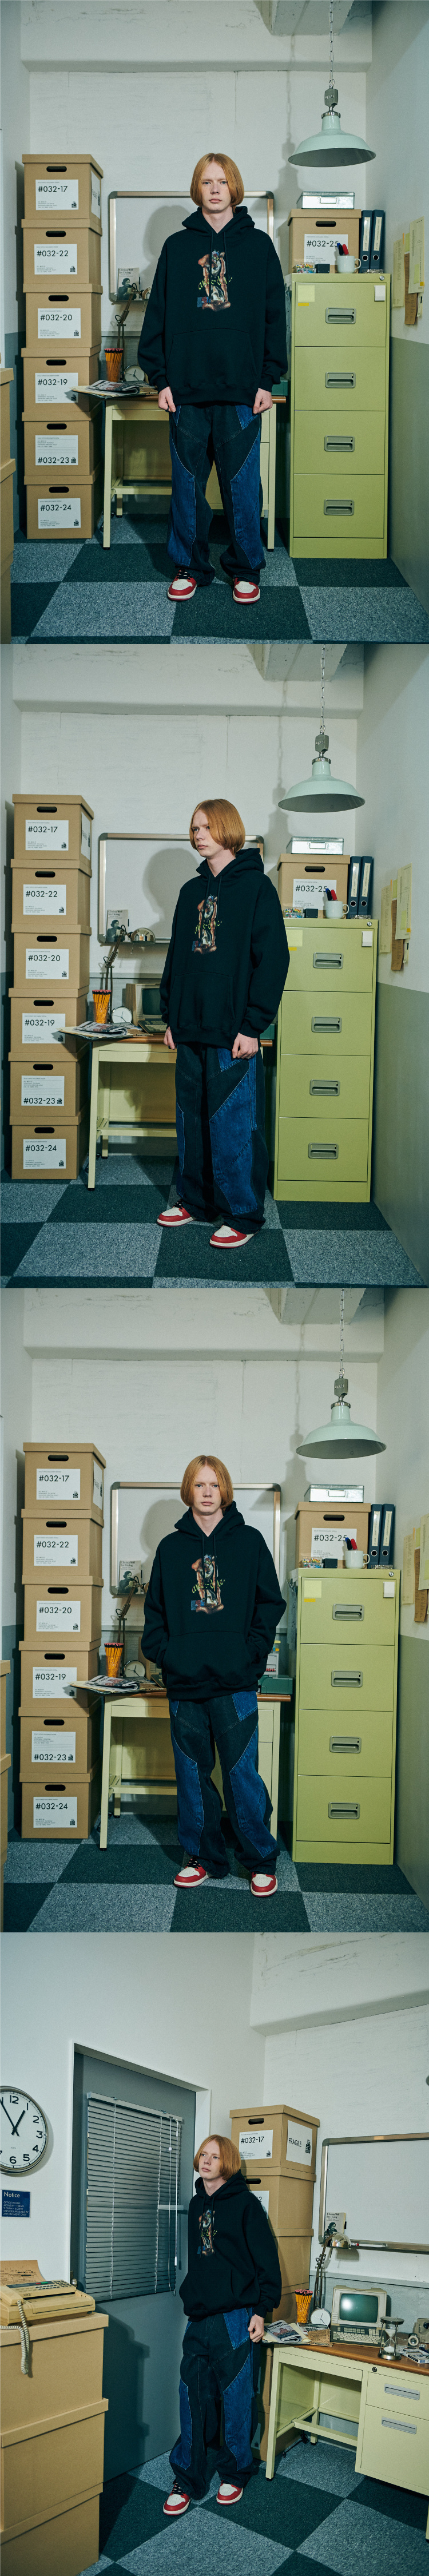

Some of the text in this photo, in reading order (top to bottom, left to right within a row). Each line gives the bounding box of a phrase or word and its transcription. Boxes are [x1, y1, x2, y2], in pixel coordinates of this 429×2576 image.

[10, 2095, 19, 2104] 12
[26, 2102, 29, 2110] 1
[33, 2115, 39, 2123] 2
[36, 2130, 43, 2138] 3
[241, 2136, 264, 2144] #032-17
[288, 2137, 302, 2148] FRAGILE
[32, 2145, 39, 2153] 4
[9, 2156, 17, 2164] 6
[23, 2153, 30, 2162] 5
